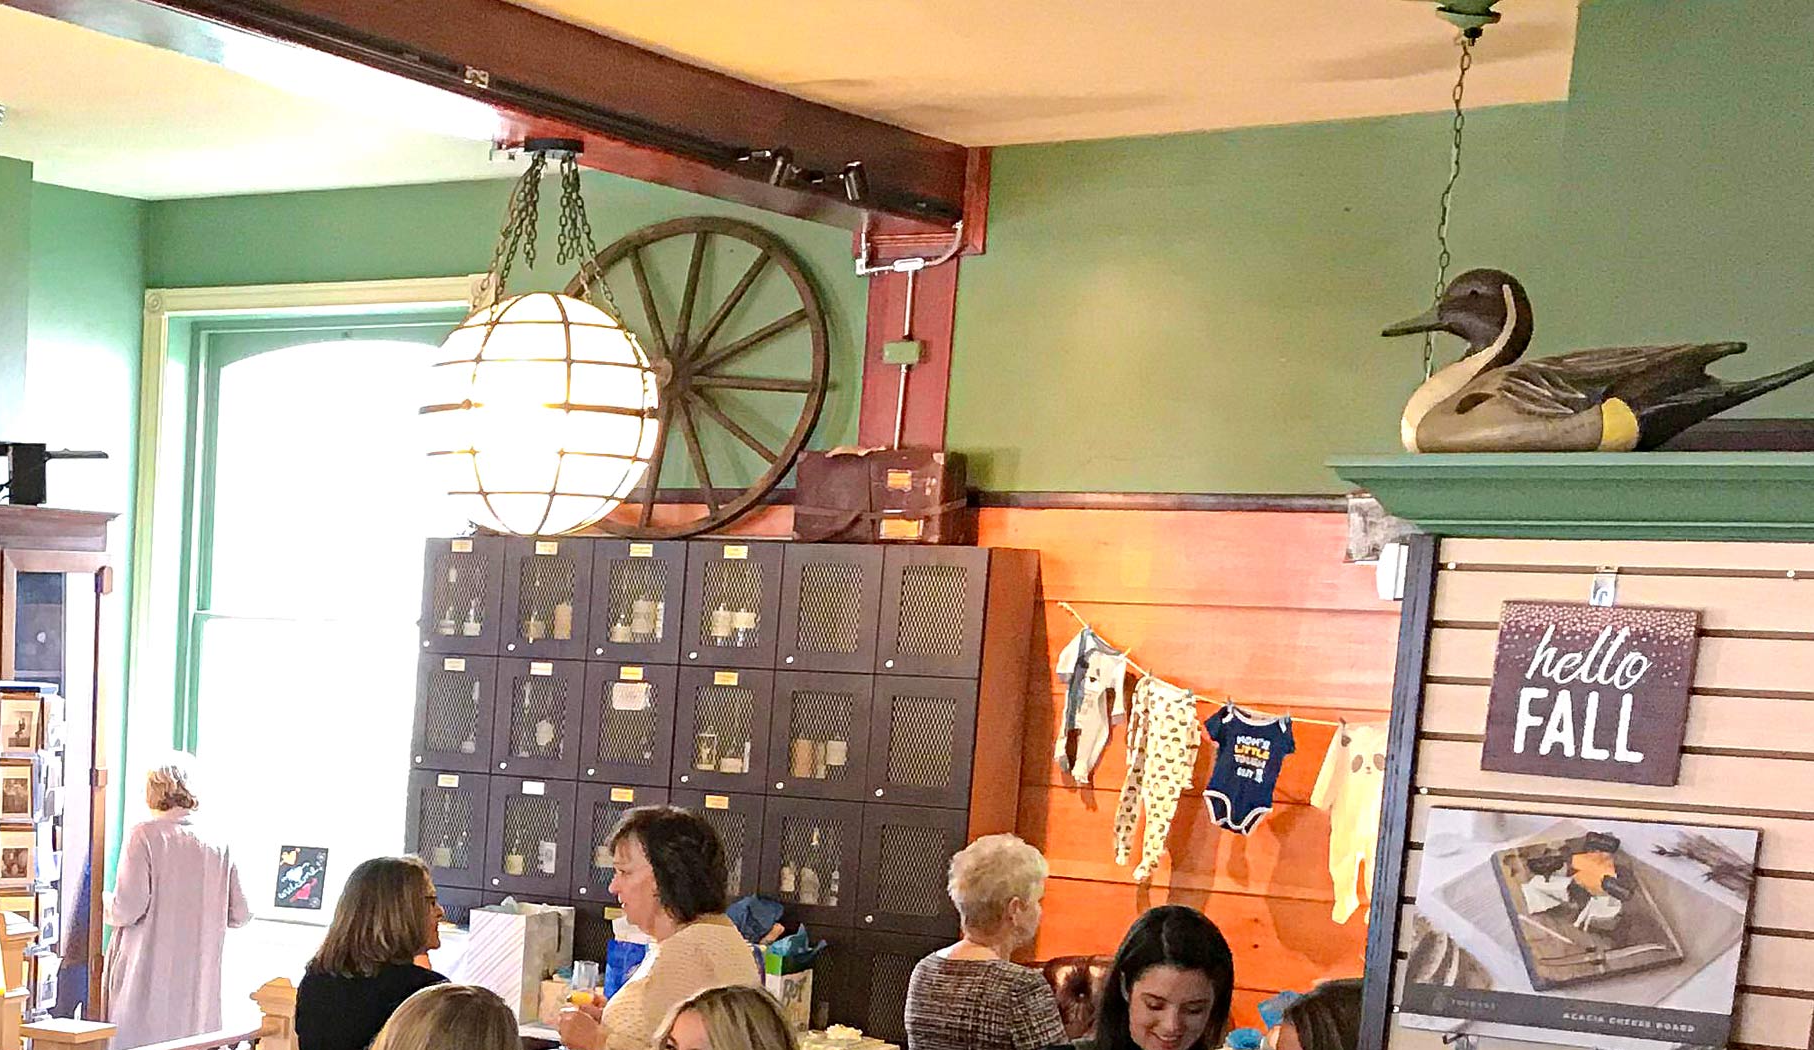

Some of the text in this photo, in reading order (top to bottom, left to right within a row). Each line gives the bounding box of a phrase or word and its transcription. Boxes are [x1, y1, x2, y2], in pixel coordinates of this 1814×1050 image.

[1525, 624, 1653, 690] hello
[1234, 744, 1270, 760] LITTLE
[1513, 686, 1645, 763] FALL
